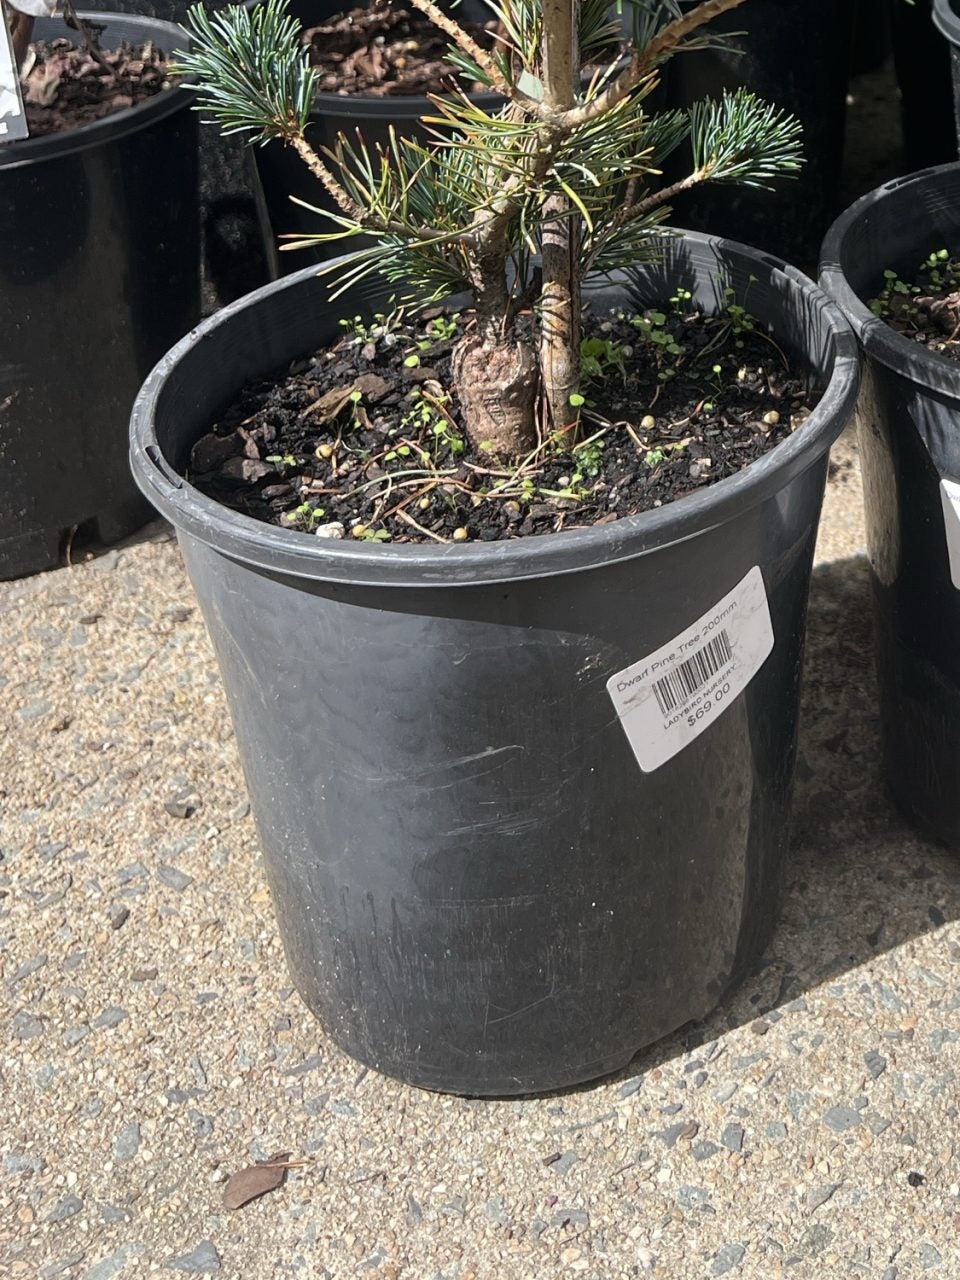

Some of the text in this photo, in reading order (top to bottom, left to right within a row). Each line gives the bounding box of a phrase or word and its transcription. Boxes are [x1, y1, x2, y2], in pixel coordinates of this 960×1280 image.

[617, 601, 737, 692] Dwarf Pine Tree 200mm
[664, 696, 703, 730] LADYBIRD
[703, 664, 736, 697] NURSERY
[688, 682, 730, 726] $69.00
